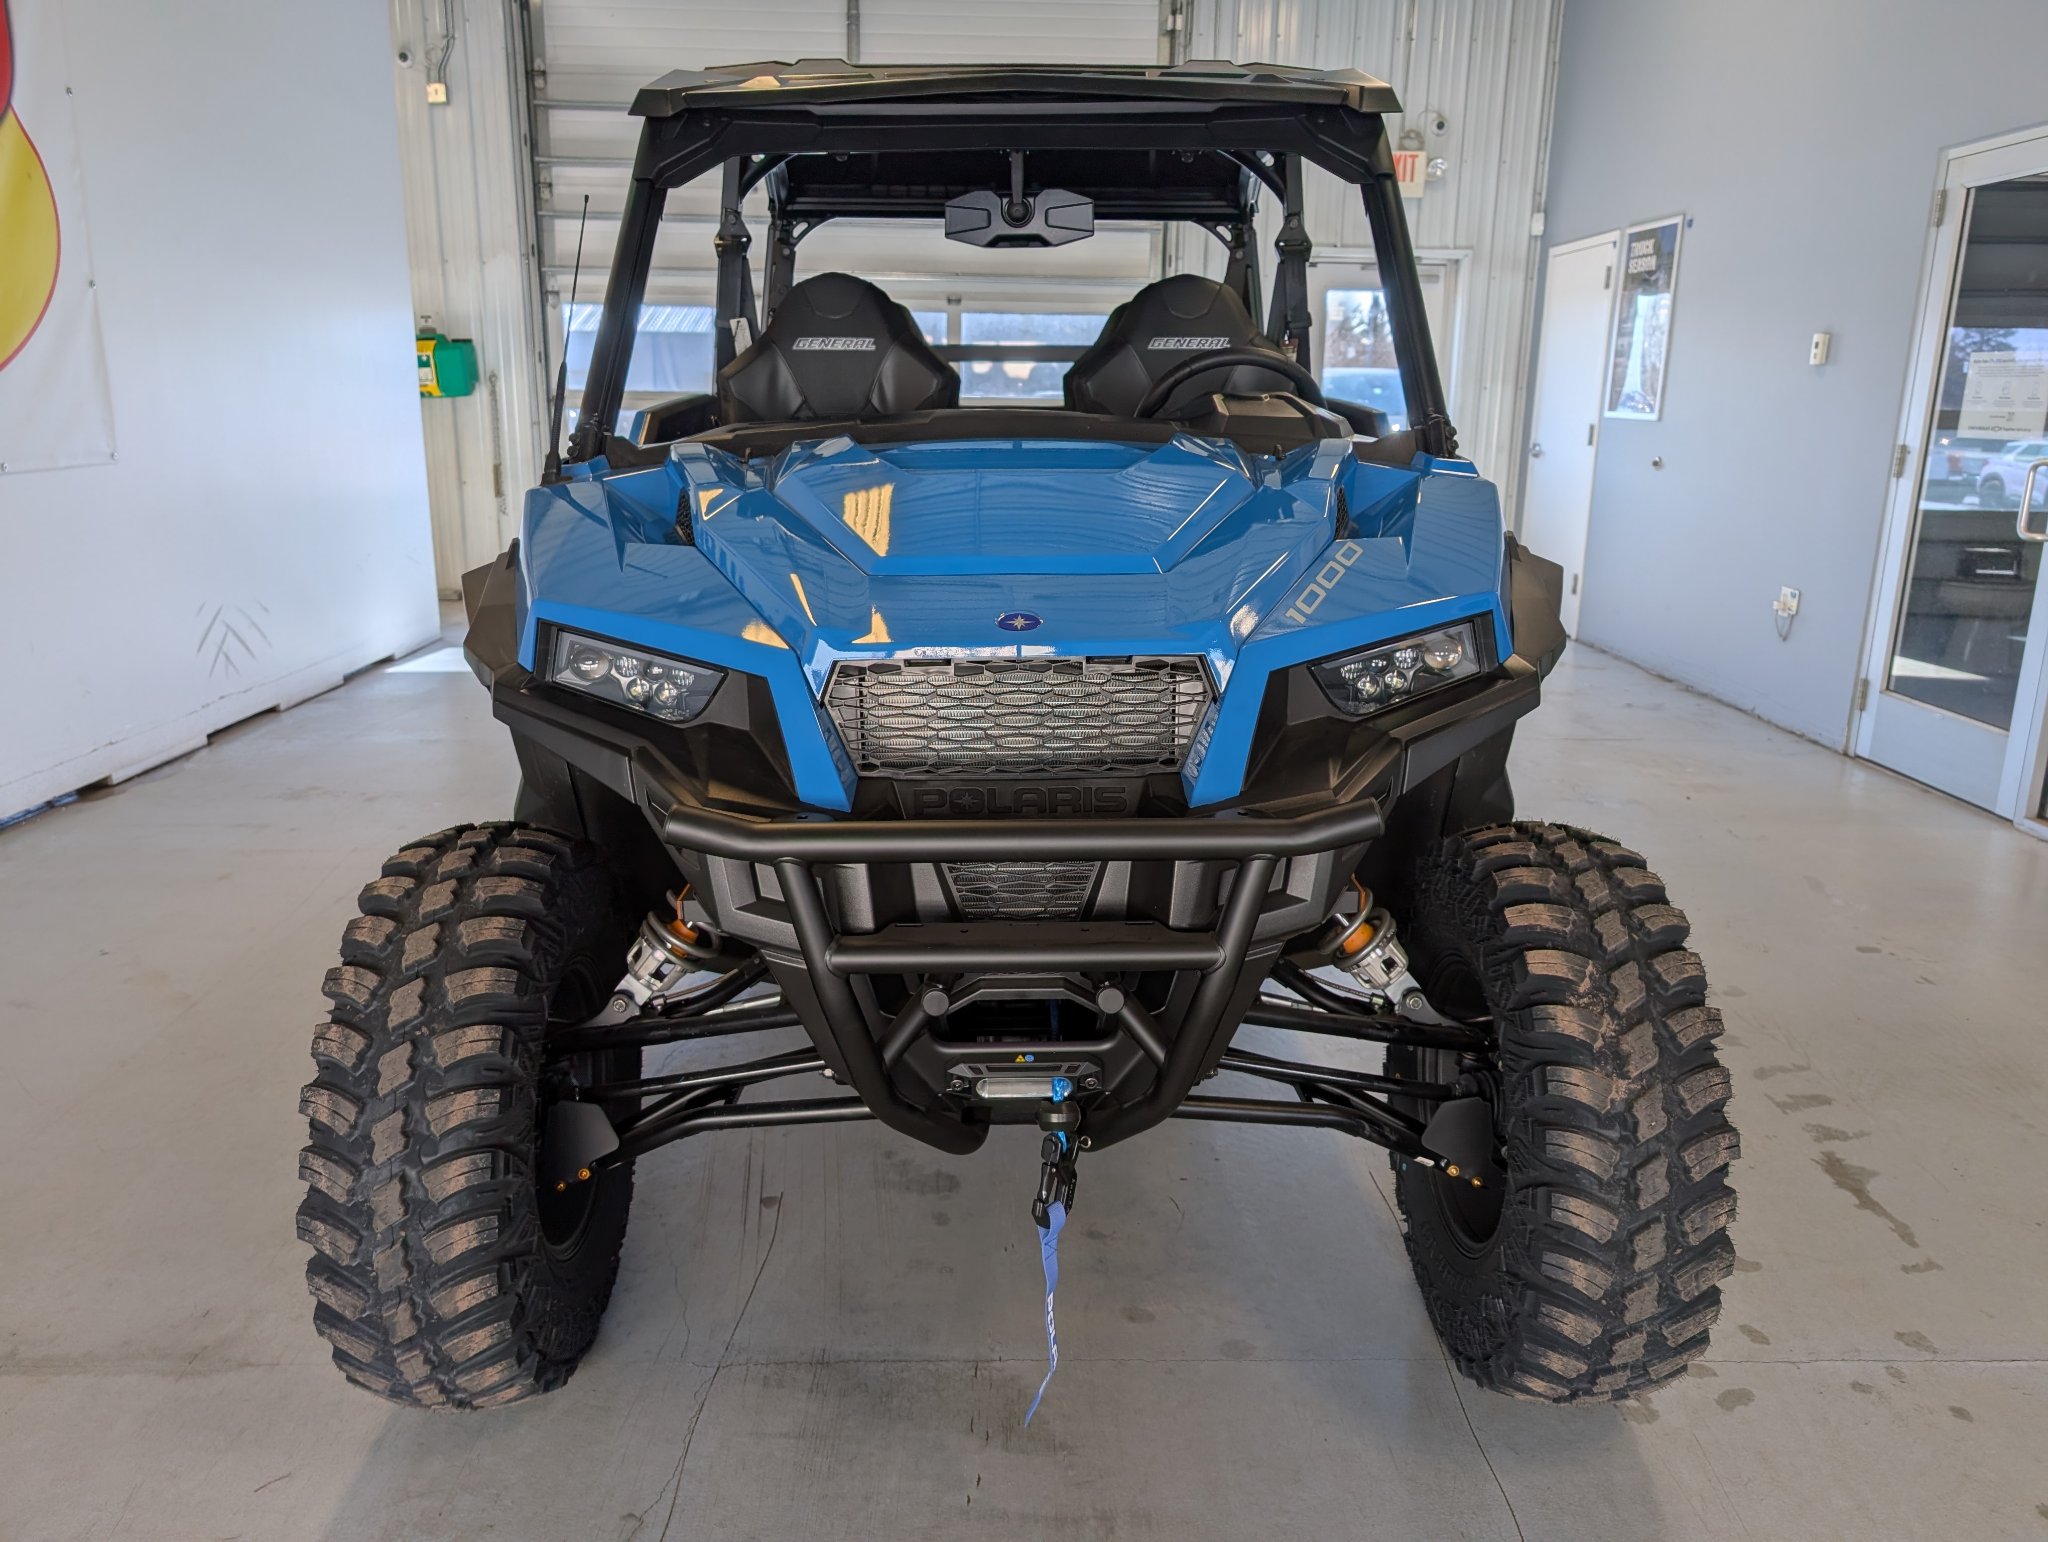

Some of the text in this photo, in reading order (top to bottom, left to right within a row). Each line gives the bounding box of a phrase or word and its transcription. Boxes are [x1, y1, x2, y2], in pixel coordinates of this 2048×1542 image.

[1392, 153, 1419, 183] XIT
[1630, 238, 1656, 257] TRUCK
[1628, 254, 1657, 274] SEASON
[792, 337, 877, 351] GENERAL
[1147, 337, 1231, 350] GENERAL
[1285, 541, 1364, 625] 1000
[913, 786, 1128, 815] POLARIS
